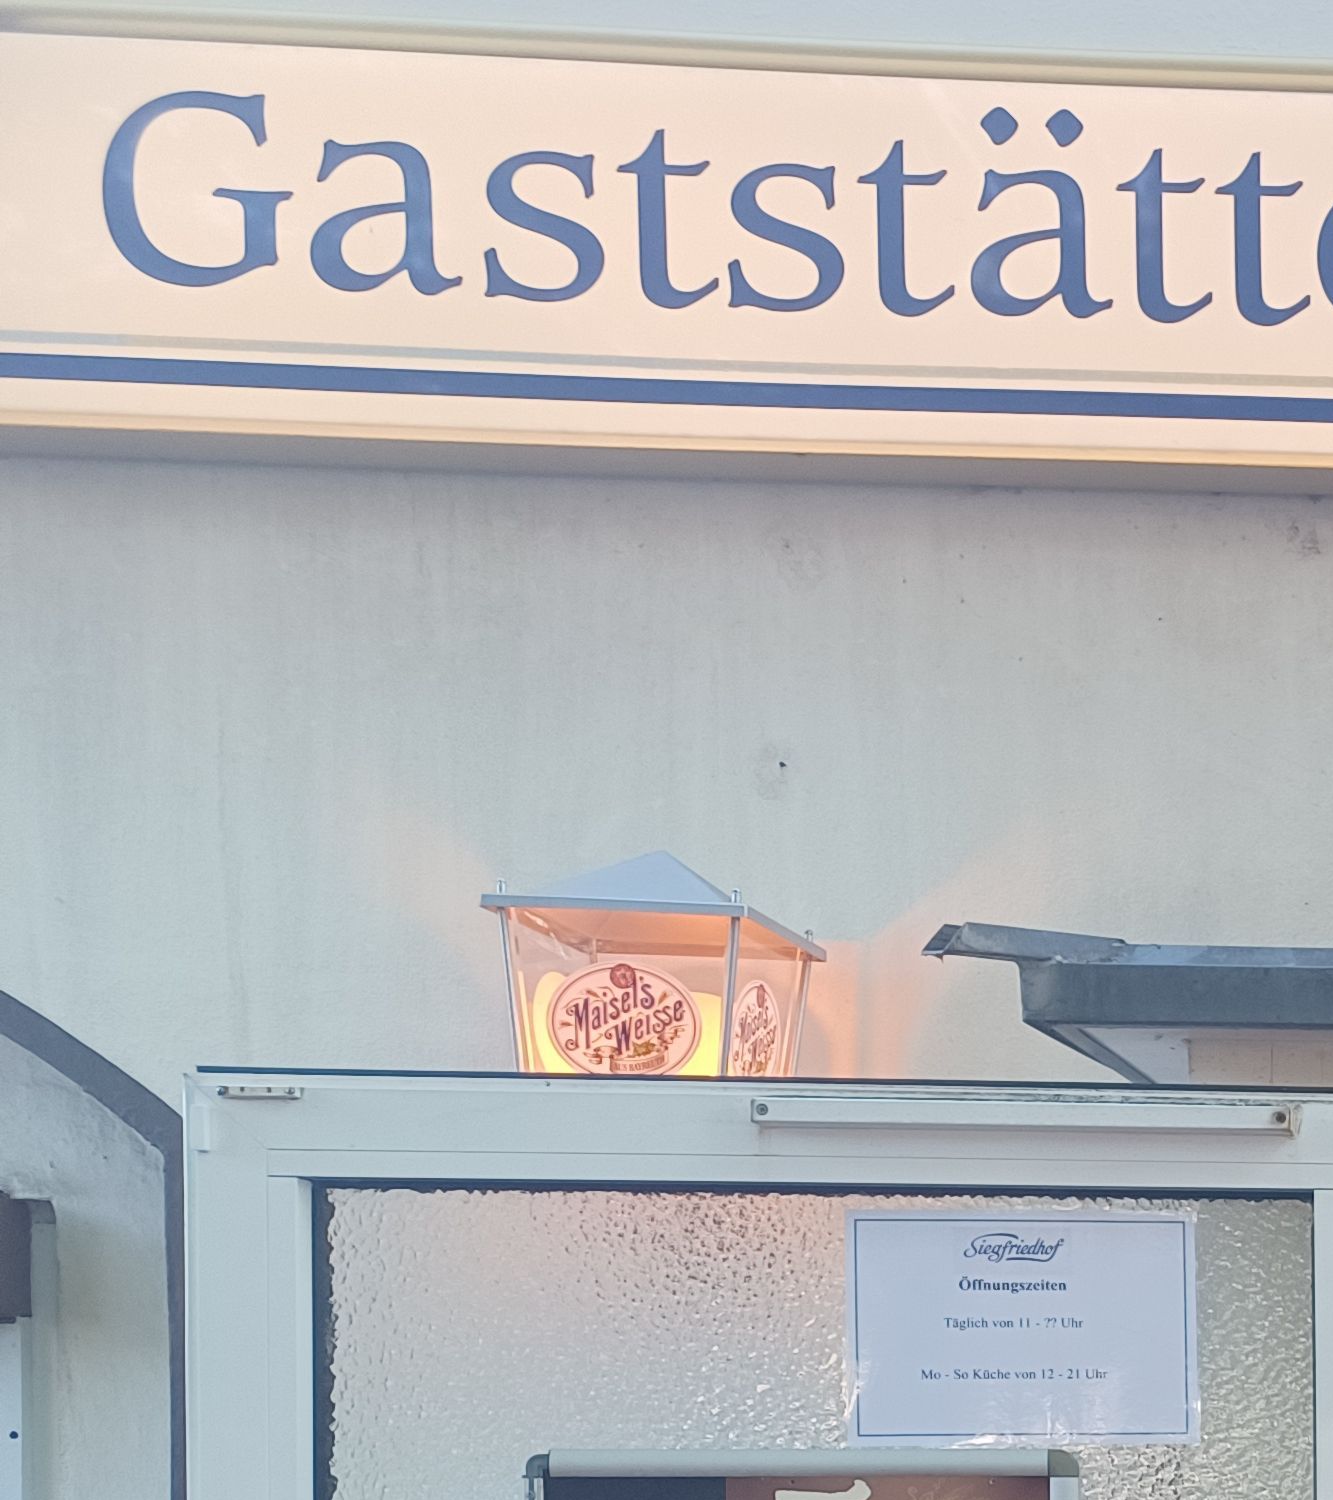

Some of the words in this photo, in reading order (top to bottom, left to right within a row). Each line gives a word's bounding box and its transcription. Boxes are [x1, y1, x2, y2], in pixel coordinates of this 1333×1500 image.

[604, 1000, 686, 1056] Weisse
[963, 1232, 1065, 1263] Siegfriedhof
[959, 1276, 1067, 1294] Öffnungszeiten
[944, 1317, 989, 1331] Täglich
[993, 1320, 1014, 1328] von
[1019, 1317, 1030, 1328] 11
[1061, 1317, 1084, 1328] Uhr
[921, 1369, 941, 1380] Mo
[953, 1369, 969, 1380] So
[973, 1368, 1011, 1380] Küche
[1014, 1372, 1036, 1380] von
[1041, 1369, 1054, 1380] 12
[1067, 1369, 1080, 1380] 21
[1085, 1368, 1109, 1380] Uhr
